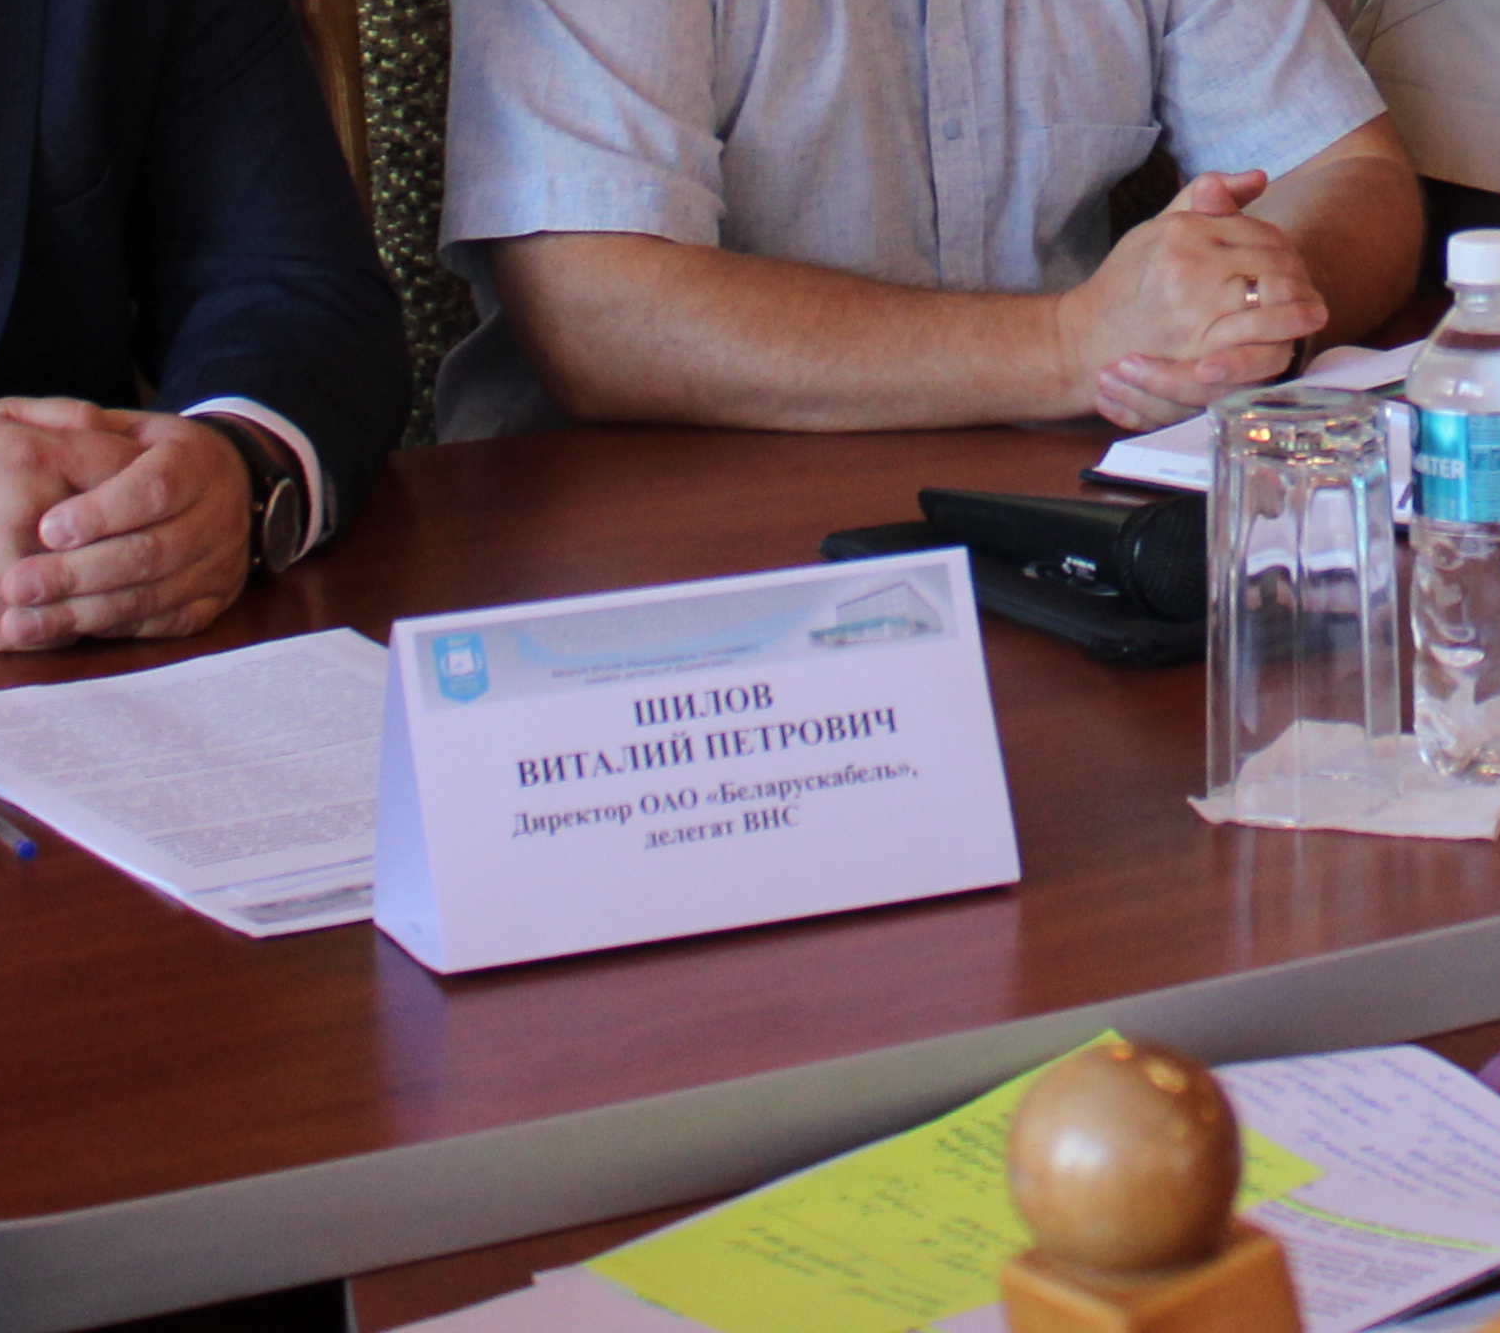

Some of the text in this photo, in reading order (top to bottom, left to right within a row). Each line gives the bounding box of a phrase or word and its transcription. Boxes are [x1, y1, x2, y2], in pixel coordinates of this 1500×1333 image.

[632, 681, 775, 728] ШИЛОВ
[516, 705, 899, 789] ВИТАЛИЙ ПЕТРОВИЧ
[511, 761, 920, 840] Директор ОАО «Беларускабель»,
[644, 805, 801, 851] делегат ВНС
